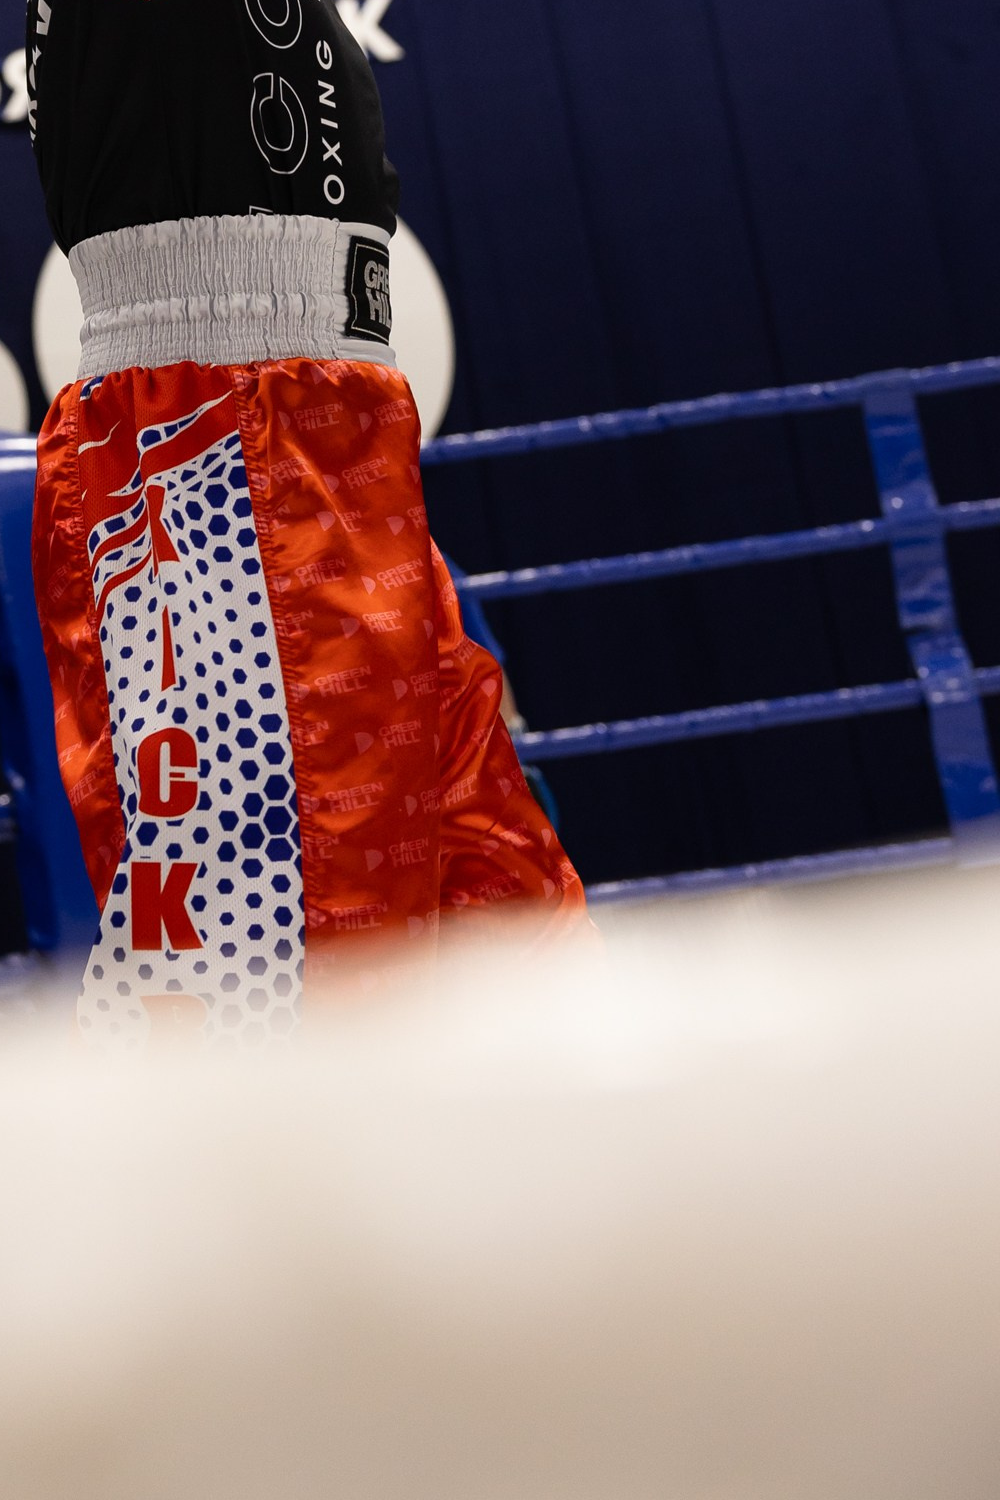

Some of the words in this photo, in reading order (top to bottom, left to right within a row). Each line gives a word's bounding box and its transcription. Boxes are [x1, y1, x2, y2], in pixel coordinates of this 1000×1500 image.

[316, 40, 346, 206] OXING
[364, 260, 390, 296] GRE
[365, 287, 392, 330] HIL
